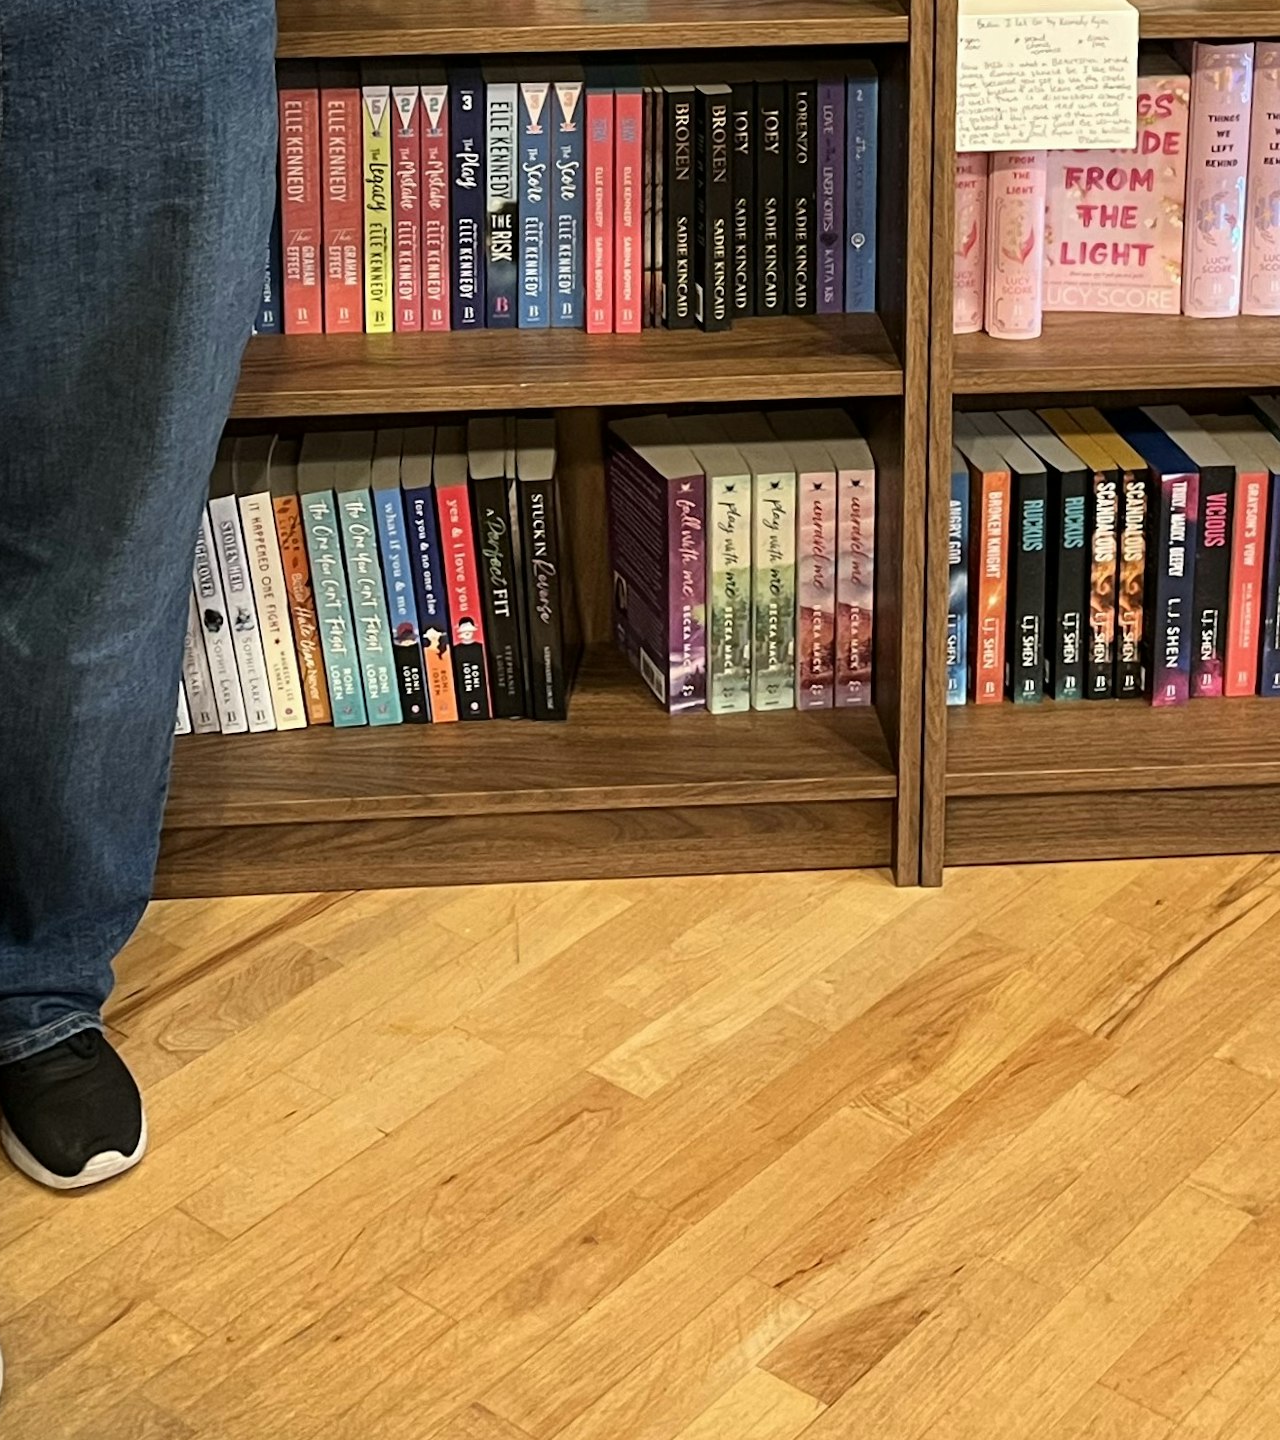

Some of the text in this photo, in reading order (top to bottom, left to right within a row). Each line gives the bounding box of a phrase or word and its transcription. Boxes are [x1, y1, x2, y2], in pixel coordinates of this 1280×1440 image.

[1064, 168, 1154, 192] FROM
[1076, 205, 1138, 230] THE
[490, 214, 513, 262] THE RISK
[1060, 243, 1154, 266] LIGHT
[1098, 287, 1173, 307] SCORE
[1022, 500, 1044, 552] RUCKUS
[1095, 482, 1117, 562] SCANDALOUS
[1205, 493, 1227, 547] VICIOUS
